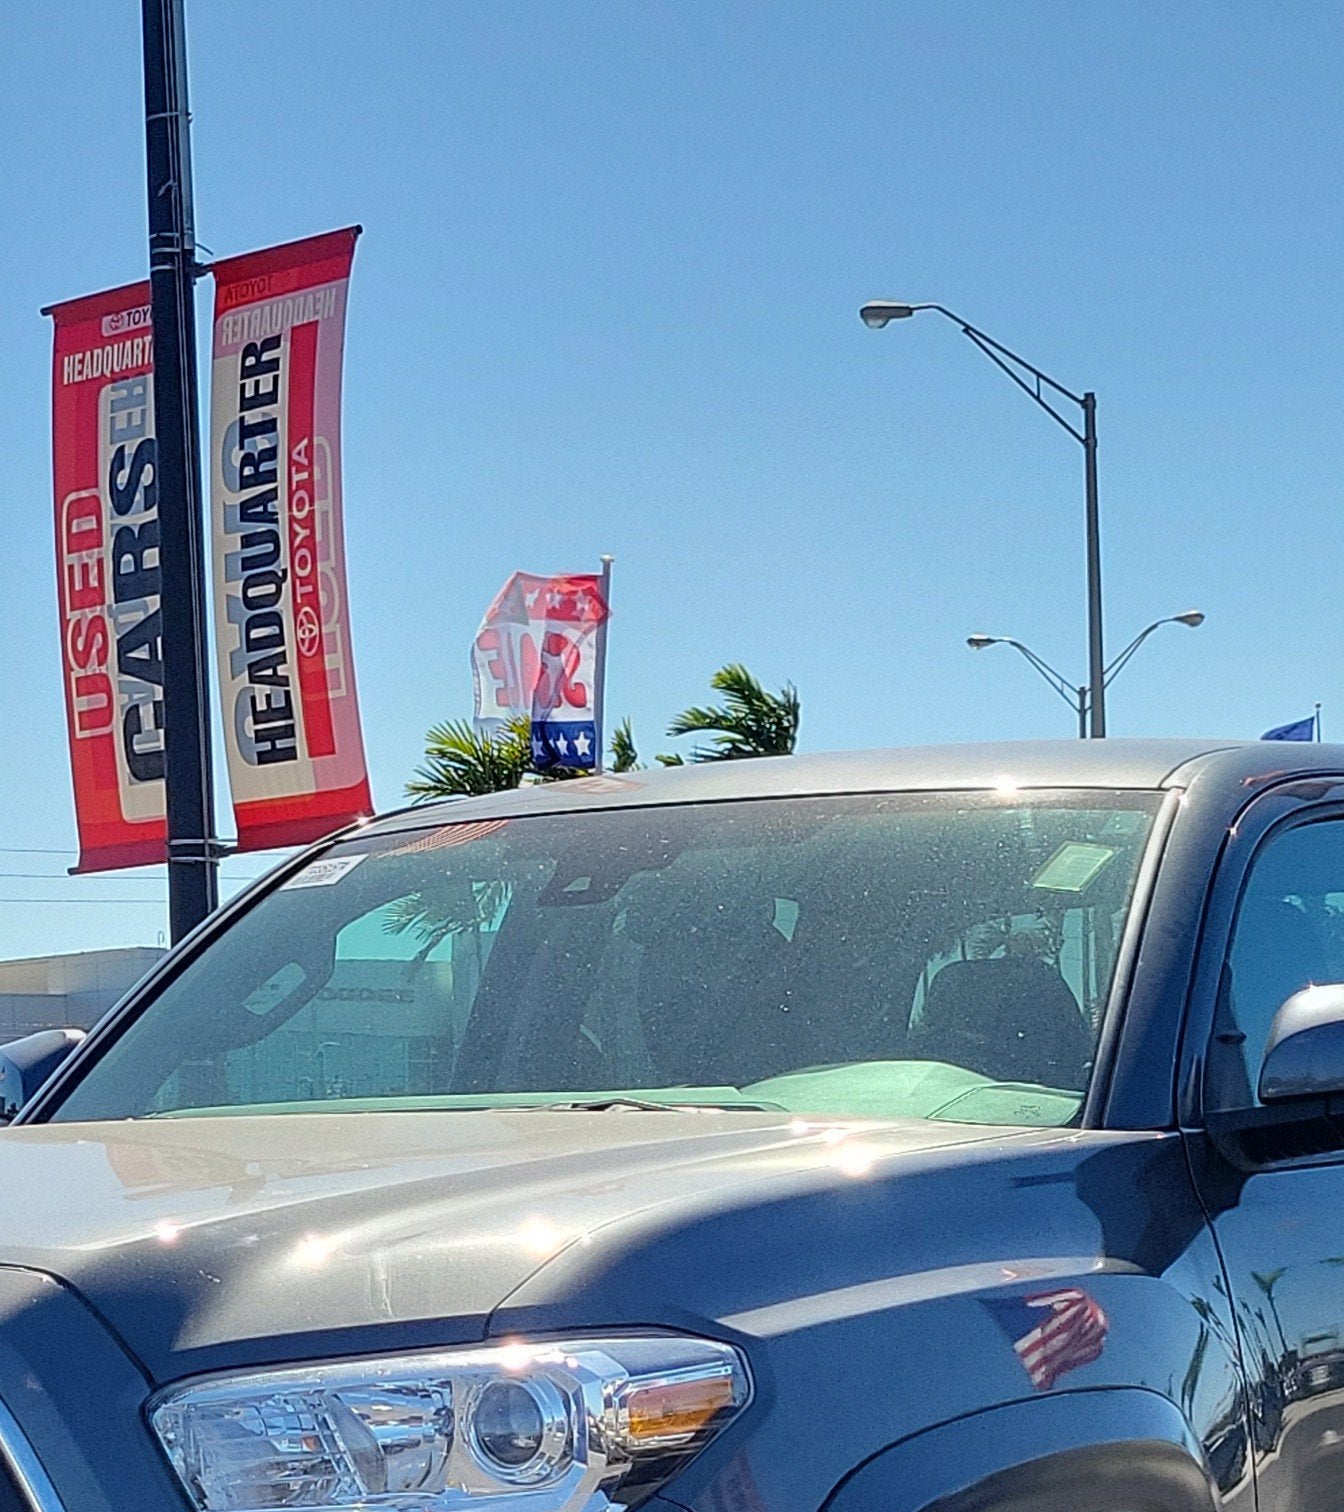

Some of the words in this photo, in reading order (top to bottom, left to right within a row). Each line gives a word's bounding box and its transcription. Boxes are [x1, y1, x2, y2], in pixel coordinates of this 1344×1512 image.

[63, 490, 114, 737] USED
[110, 437, 166, 782] CARS
[240, 333, 299, 766] HEADQUARTER
[292, 437, 313, 604] TOYOTA
